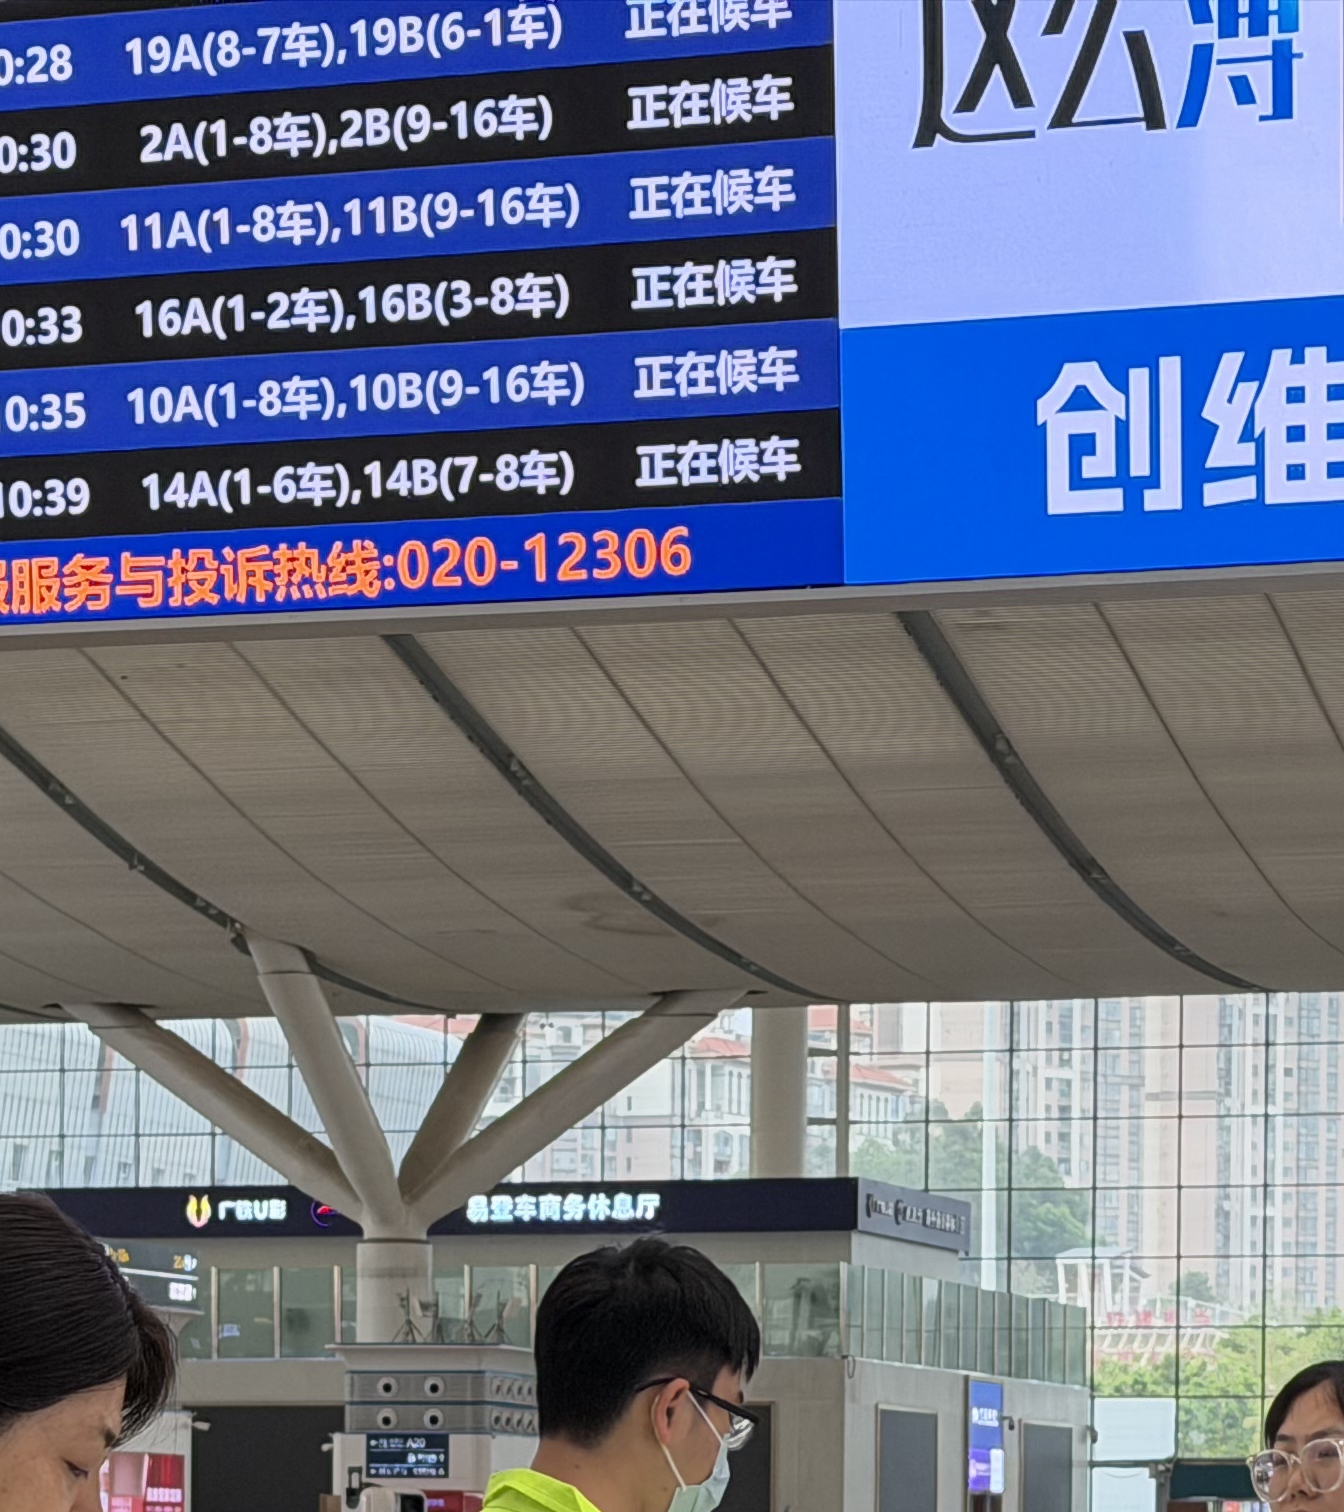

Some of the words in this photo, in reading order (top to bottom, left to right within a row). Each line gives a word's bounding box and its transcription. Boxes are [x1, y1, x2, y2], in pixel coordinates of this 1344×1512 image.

[126, 4, 561, 76] 19A(8-7车),19B(6-1车)
[625, 0, 792, 38] 正在候车
[141, 95, 552, 165] 2A(1-8车),2B(9-16车)
[627, 74, 794, 129] 正在候车
[121, 183, 579, 253] 11A(1-8车),11B(9-16车)
[630, 166, 795, 219] 正在候车
[136, 273, 569, 340] 16A(1-2车),16B(3-8车)
[631, 256, 798, 309] 正在候车
[128, 361, 584, 427] 10A(1-8车),10B(9-16车)
[634, 346, 799, 398] 正在候车
[142, 450, 574, 513] 14A(1-6车),14B(7-8车)
[636, 436, 801, 486] 正在候车
[466, 1192, 661, 1223] 易登车商务休息厅
